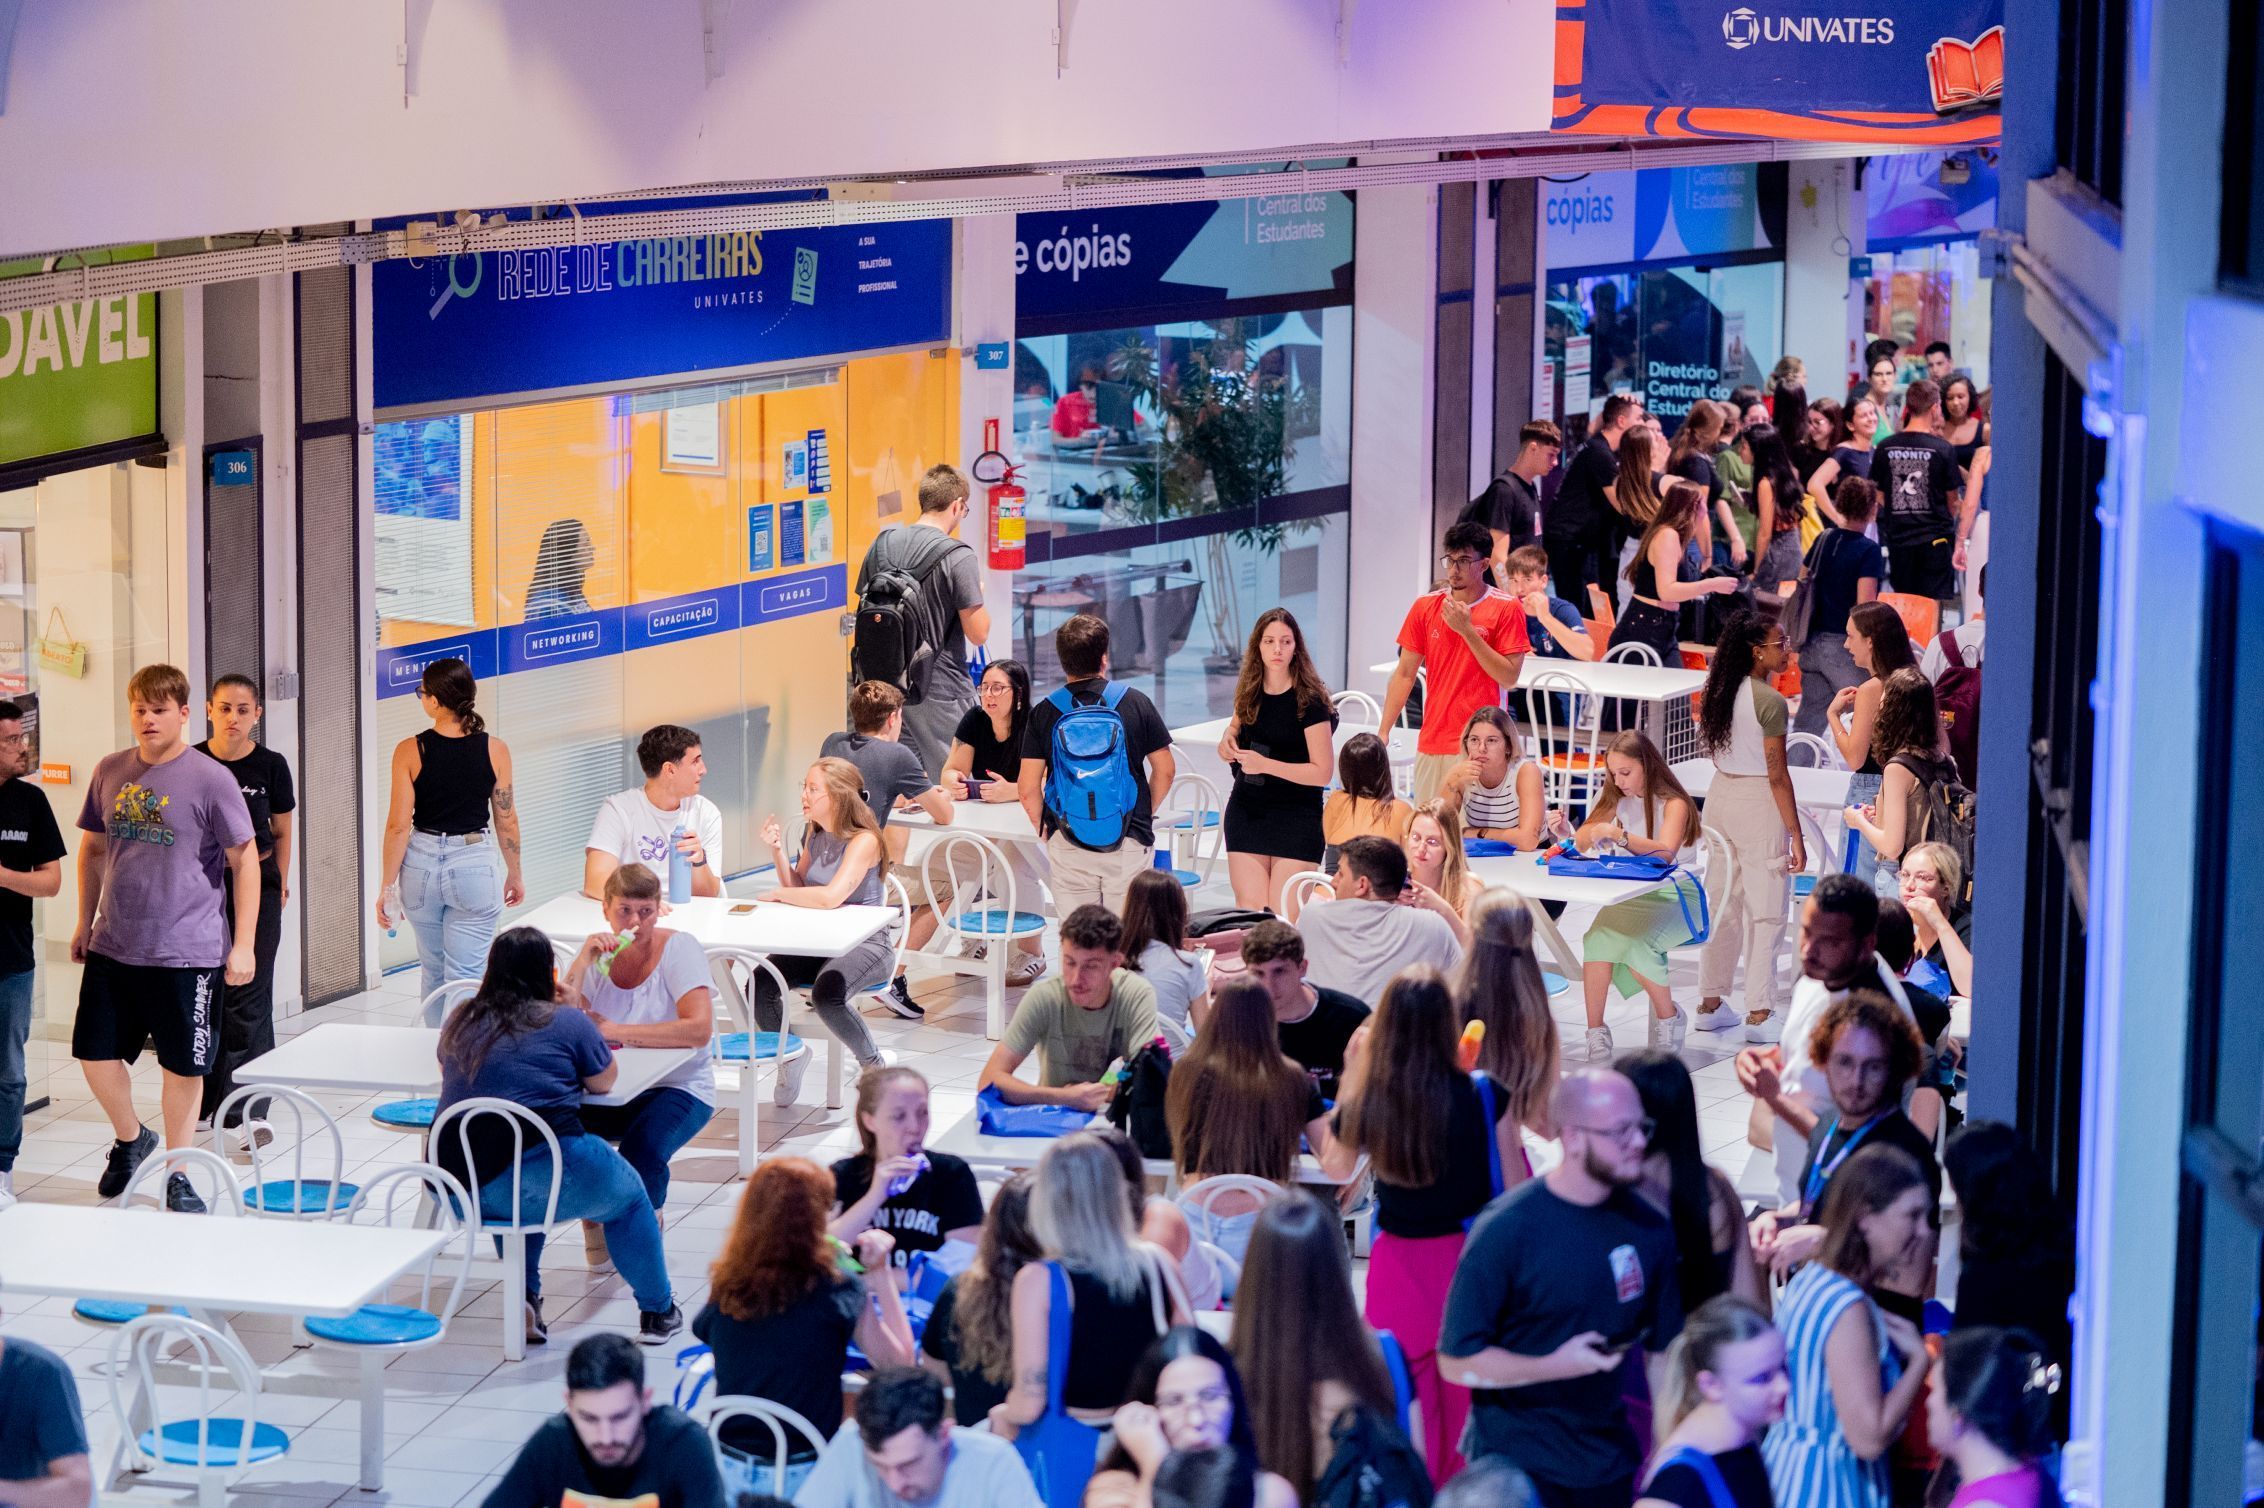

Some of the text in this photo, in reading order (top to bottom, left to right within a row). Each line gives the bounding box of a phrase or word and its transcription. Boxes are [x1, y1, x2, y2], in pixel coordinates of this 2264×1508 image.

[1763, 16, 1895, 45] UNIVATES
[1256, 192, 1327, 216] Central dos
[1546, 186, 1614, 235] cópias
[1256, 220, 1326, 243] Estudantes
[1036, 223, 1132, 282] cópias
[498, 230, 764, 301] REDE DE CARREIRAS
[858, 280, 897, 294] PROFISSIONAL
[694, 290, 764, 309] UNIVATES
[988, 350, 1004, 361] 307
[1648, 361, 1719, 381] Diretório
[1647, 380, 1731, 401] Central do
[1647, 398, 1694, 417] Estud
[1887, 450, 1932, 461] ODONTO
[227, 461, 247, 474] 306
[779, 587, 812, 602] VAGAS
[653, 606, 714, 628] CAPACITAÇÃO
[532, 629, 595, 651] NETWORKING
[395, 654, 465, 677] MENTS
[108, 820, 175, 847] adidas
[192, 972, 212, 1066] ENJOY SUMMER
[892, 1207, 940, 1237] YORK
